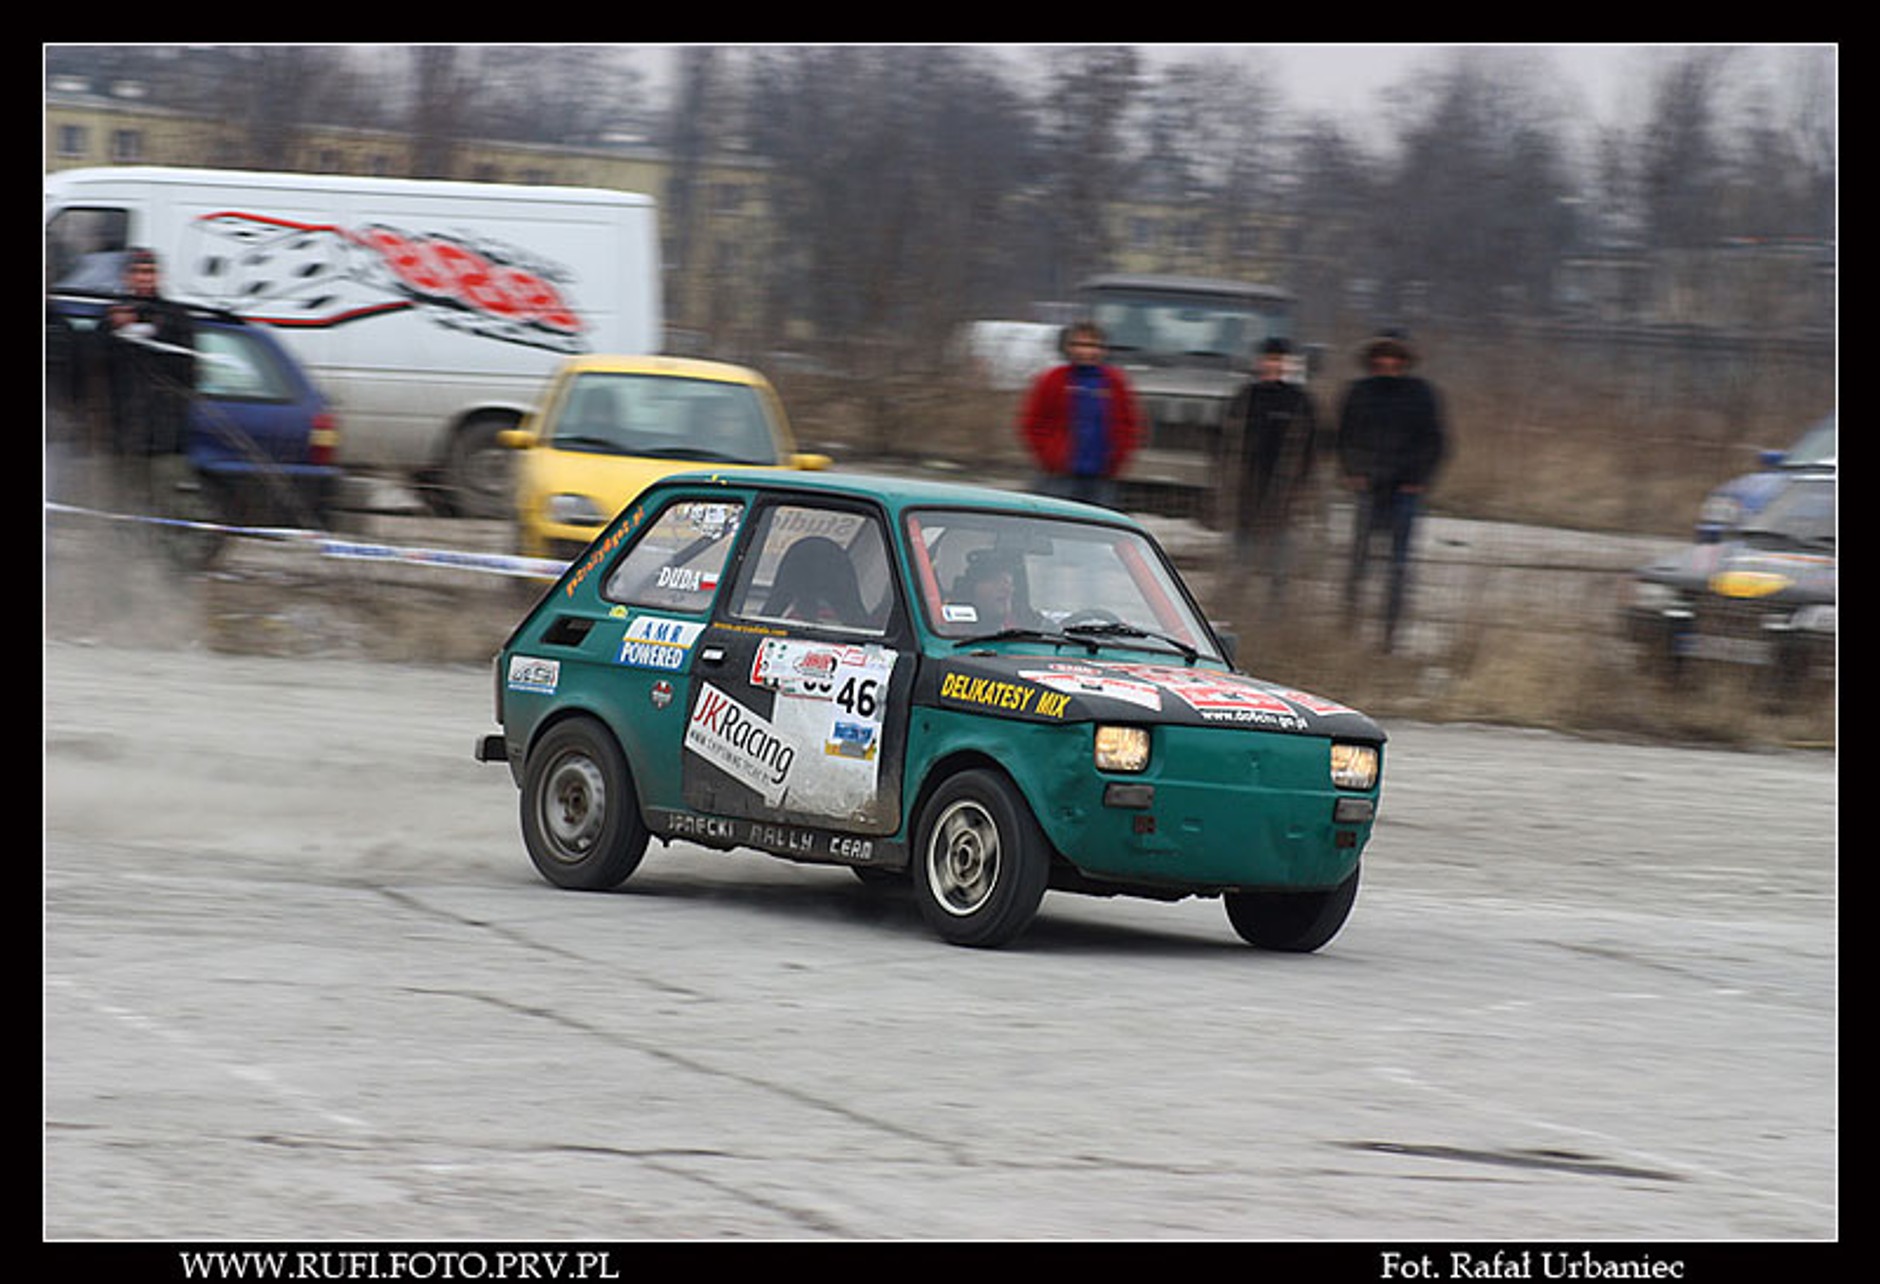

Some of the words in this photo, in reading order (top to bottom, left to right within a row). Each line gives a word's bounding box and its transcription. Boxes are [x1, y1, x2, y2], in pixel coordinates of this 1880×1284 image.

[656, 566, 700, 591] DUDA
[619, 641, 684, 669] POWERED
[836, 676, 878, 717] 46
[940, 672, 1035, 710] DELIKATESY
[1035, 694, 1072, 718] MIX
